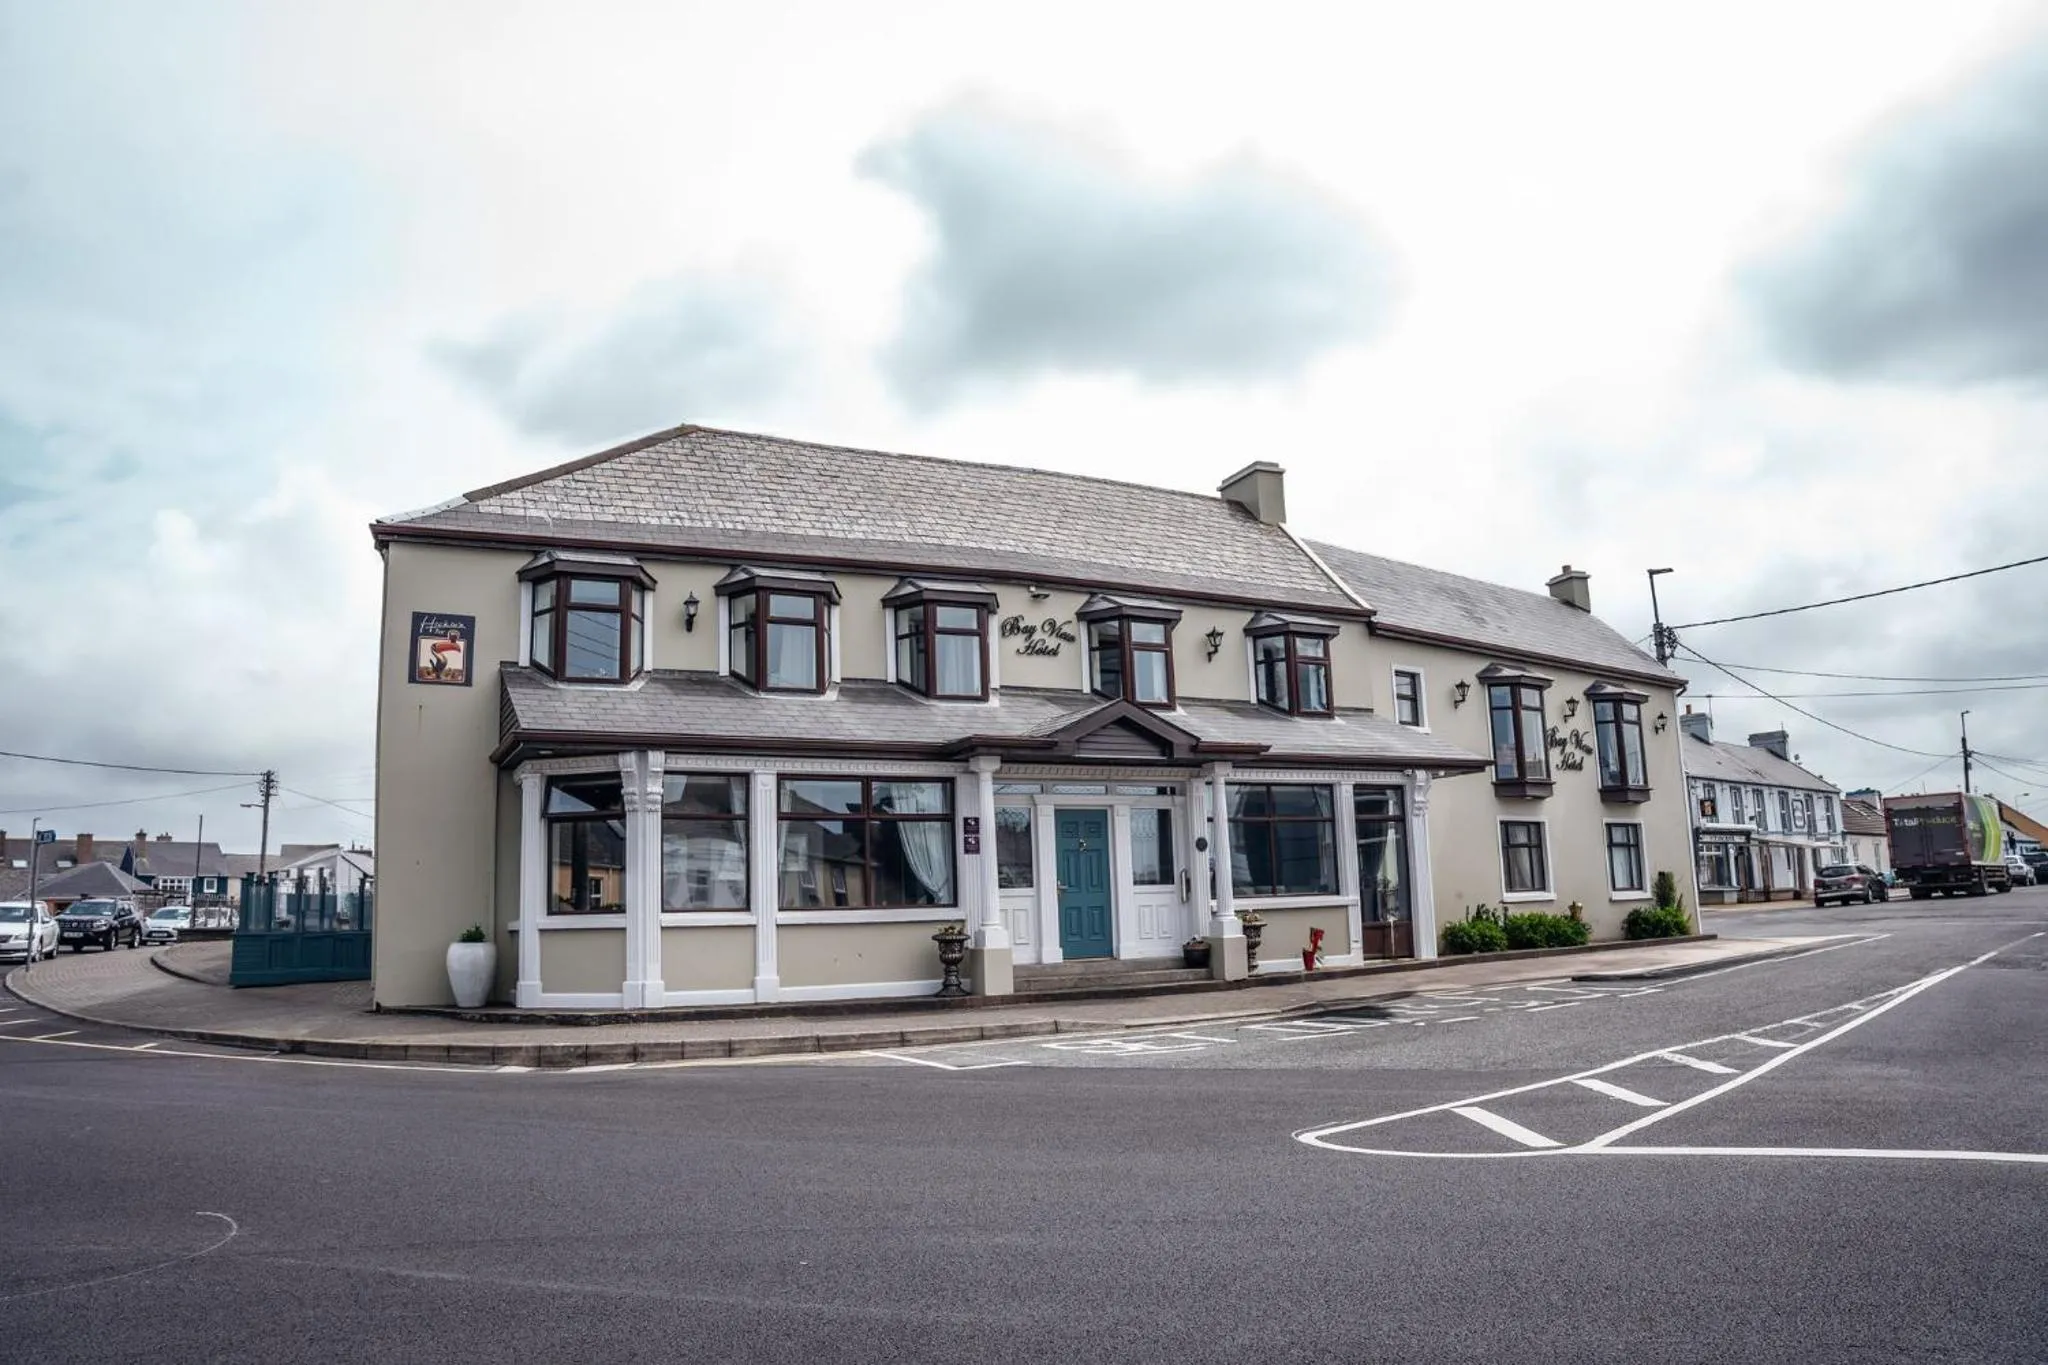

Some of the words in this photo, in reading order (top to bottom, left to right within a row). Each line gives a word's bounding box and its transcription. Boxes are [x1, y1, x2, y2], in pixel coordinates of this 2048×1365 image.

[1001, 614, 1037, 641] Bay
[1041, 618, 1076, 642] View
[1015, 638, 1062, 657] Hotel
[1547, 725, 1568, 755] Bay
[1570, 728, 1594, 755] View
[1555, 751, 1584, 771] Hotel
